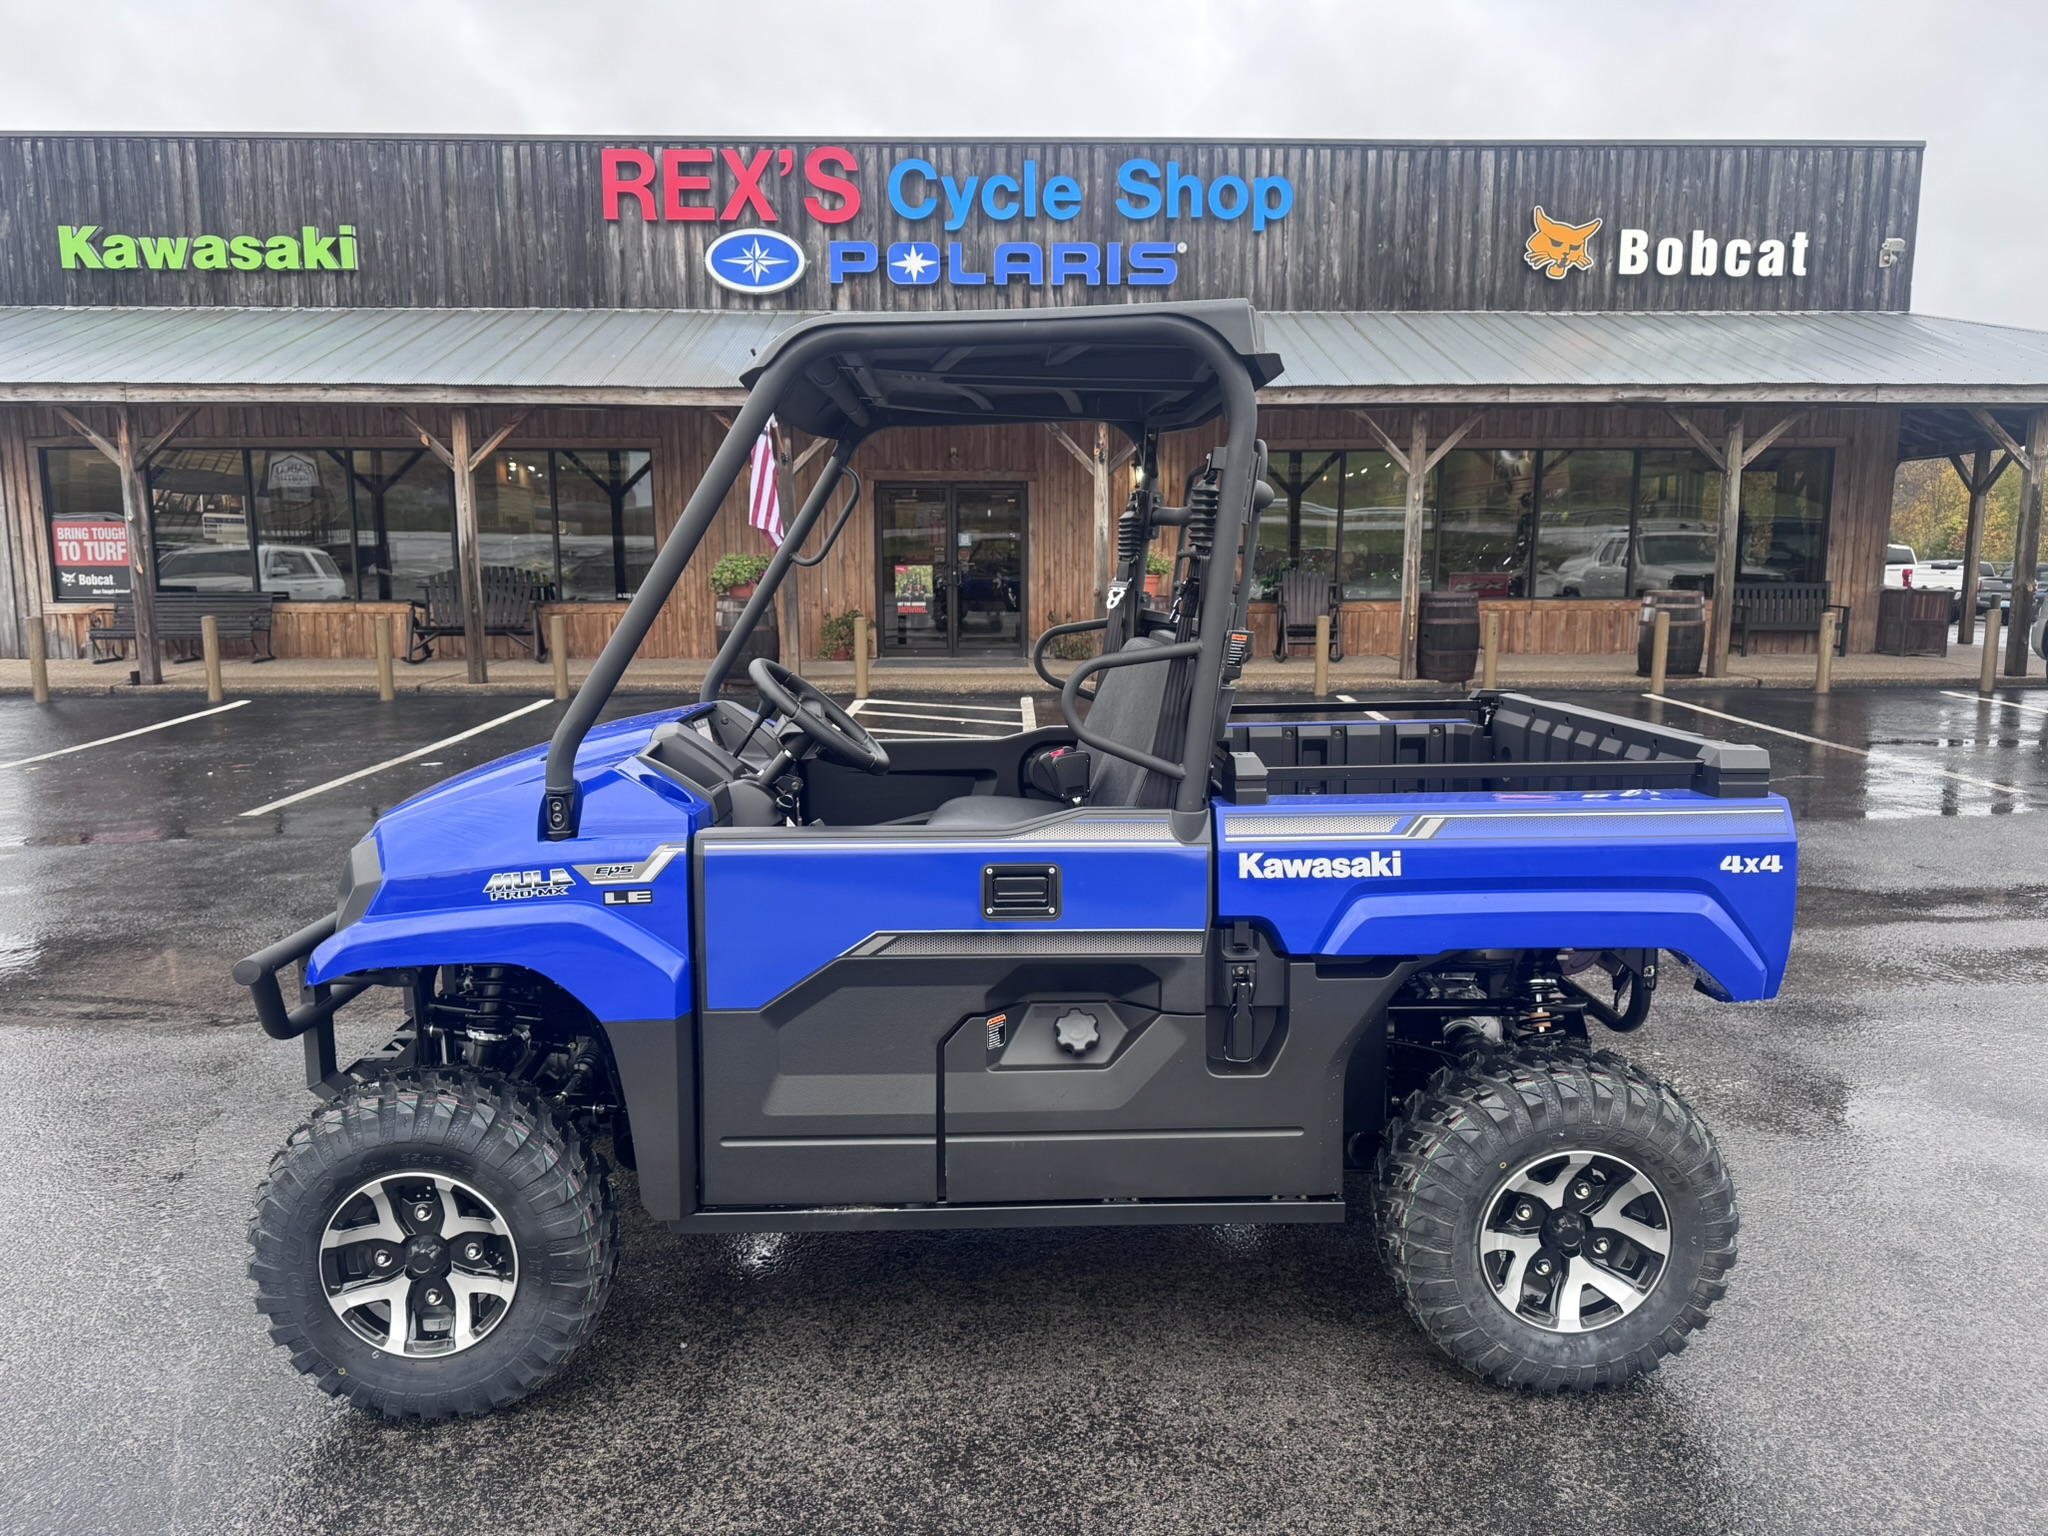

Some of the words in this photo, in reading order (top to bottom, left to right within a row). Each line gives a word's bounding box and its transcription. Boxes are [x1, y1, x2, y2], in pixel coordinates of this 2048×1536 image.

[602, 147, 861, 224] REX'S
[888, 159, 1082, 230] Cycle
[1117, 159, 1294, 231] Shop
[58, 225, 358, 271] Kawasaki
[1619, 229, 1808, 278] Bobcat
[57, 527, 89, 540] BRING
[91, 527, 126, 540] TOUGH
[58, 541, 81, 561] TO
[83, 541, 127, 561] TURF
[78, 574, 114, 585] Bobcat
[1238, 850, 1402, 879] Kawasaki
[1720, 854, 1784, 874] 4x4
[483, 868, 576, 893] MULE
[604, 891, 652, 904] LE
